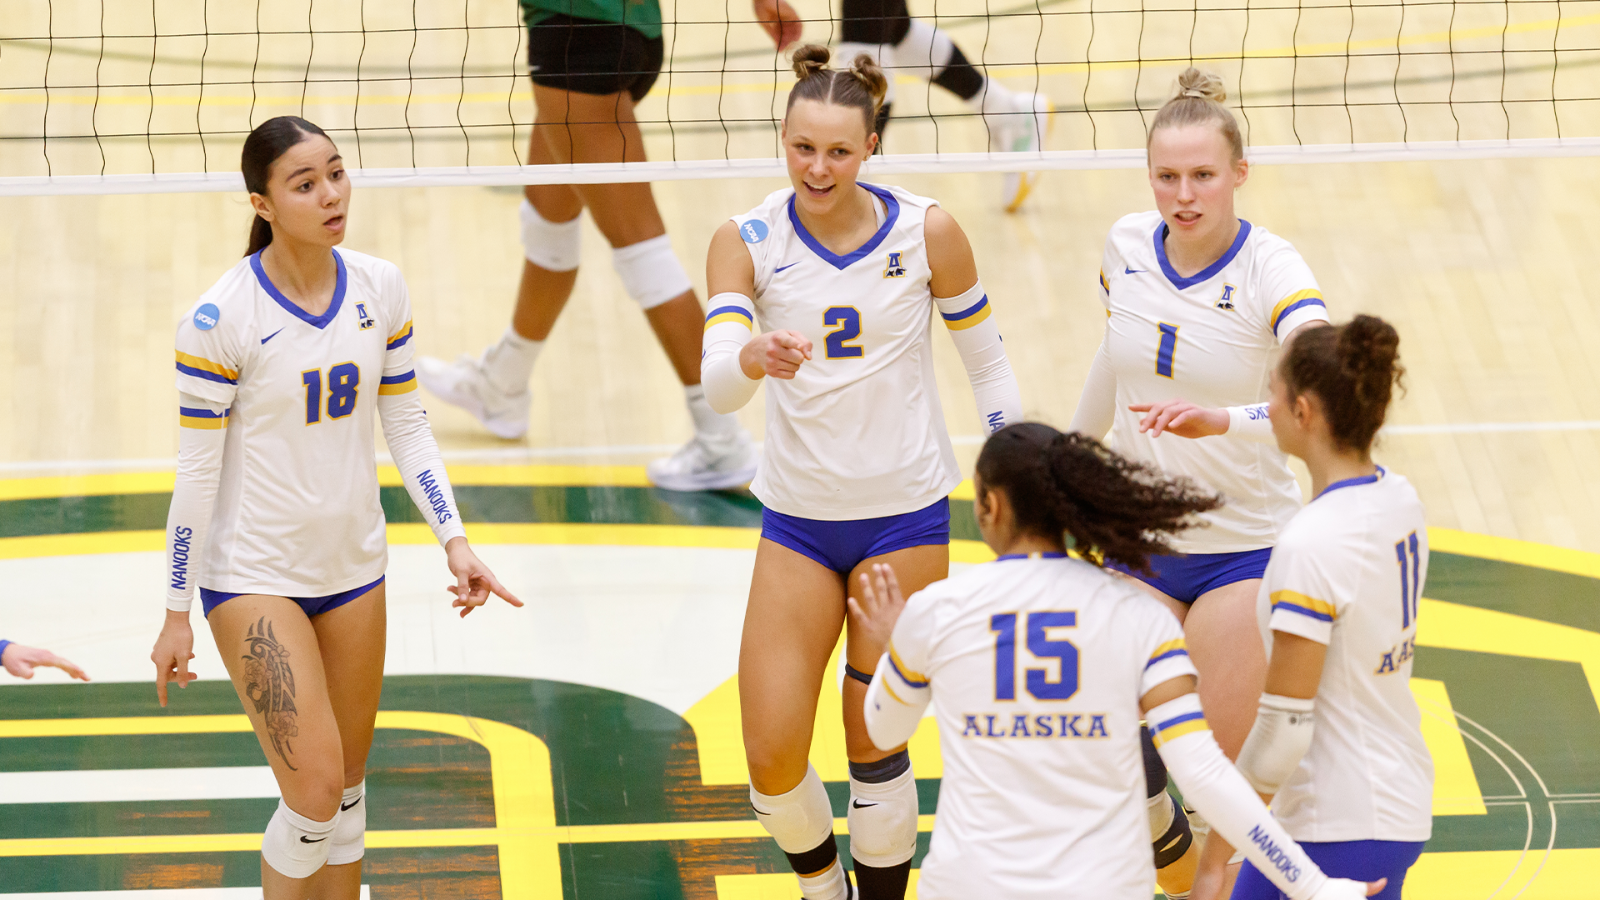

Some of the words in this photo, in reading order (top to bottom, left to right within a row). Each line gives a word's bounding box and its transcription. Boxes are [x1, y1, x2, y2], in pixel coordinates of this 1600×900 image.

[744, 223, 759, 242] NCAA
[195, 312, 216, 327] NCAA
[822, 305, 864, 360] 2
[1155, 321, 1181, 380] 1
[300, 360, 361, 426] 18
[416, 468, 453, 525] NANOOKS
[171, 525, 193, 590] NANOOKS
[1394, 529, 1420, 631] 11
[989, 610, 1081, 703] 15
[961, 713, 1112, 740] ALASKA
[1246, 823, 1302, 883] NANOOKS
